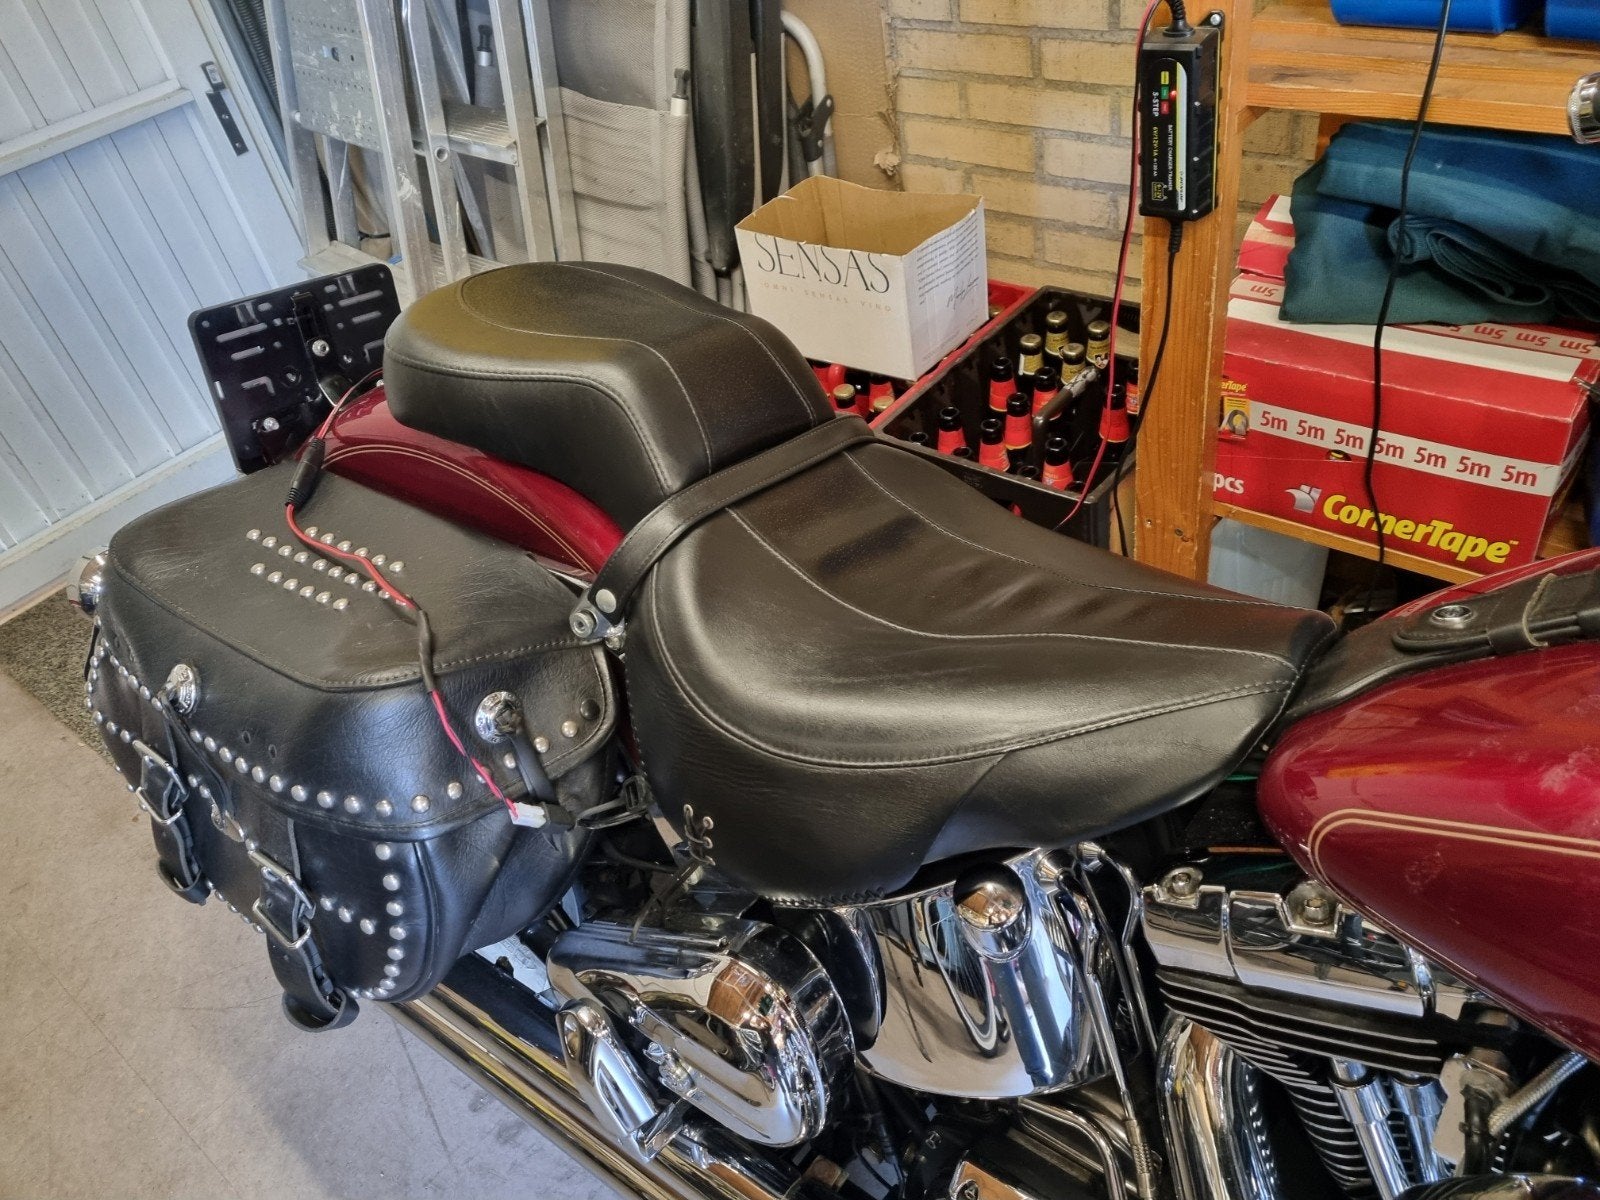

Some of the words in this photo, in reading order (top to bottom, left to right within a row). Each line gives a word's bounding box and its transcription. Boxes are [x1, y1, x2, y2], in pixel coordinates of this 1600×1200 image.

[755, 233, 890, 294] SENSAS
[1249, 285, 1279, 297] 5m
[1473, 325, 1507, 340] 5m
[1515, 332, 1551, 347] 5m
[1559, 339, 1593, 354] 5m
[1260, 410, 1288, 432] 5m
[1296, 419, 1325, 441] 5m
[1333, 427, 1364, 450] 5m
[1373, 436, 1405, 460] 5m
[1413, 446, 1447, 469] 5m
[1456, 455, 1491, 479] 5m
[1500, 464, 1538, 487] 5m
[1213, 472, 1245, 495] pcs
[1323, 494, 1511, 564] CornerTape
